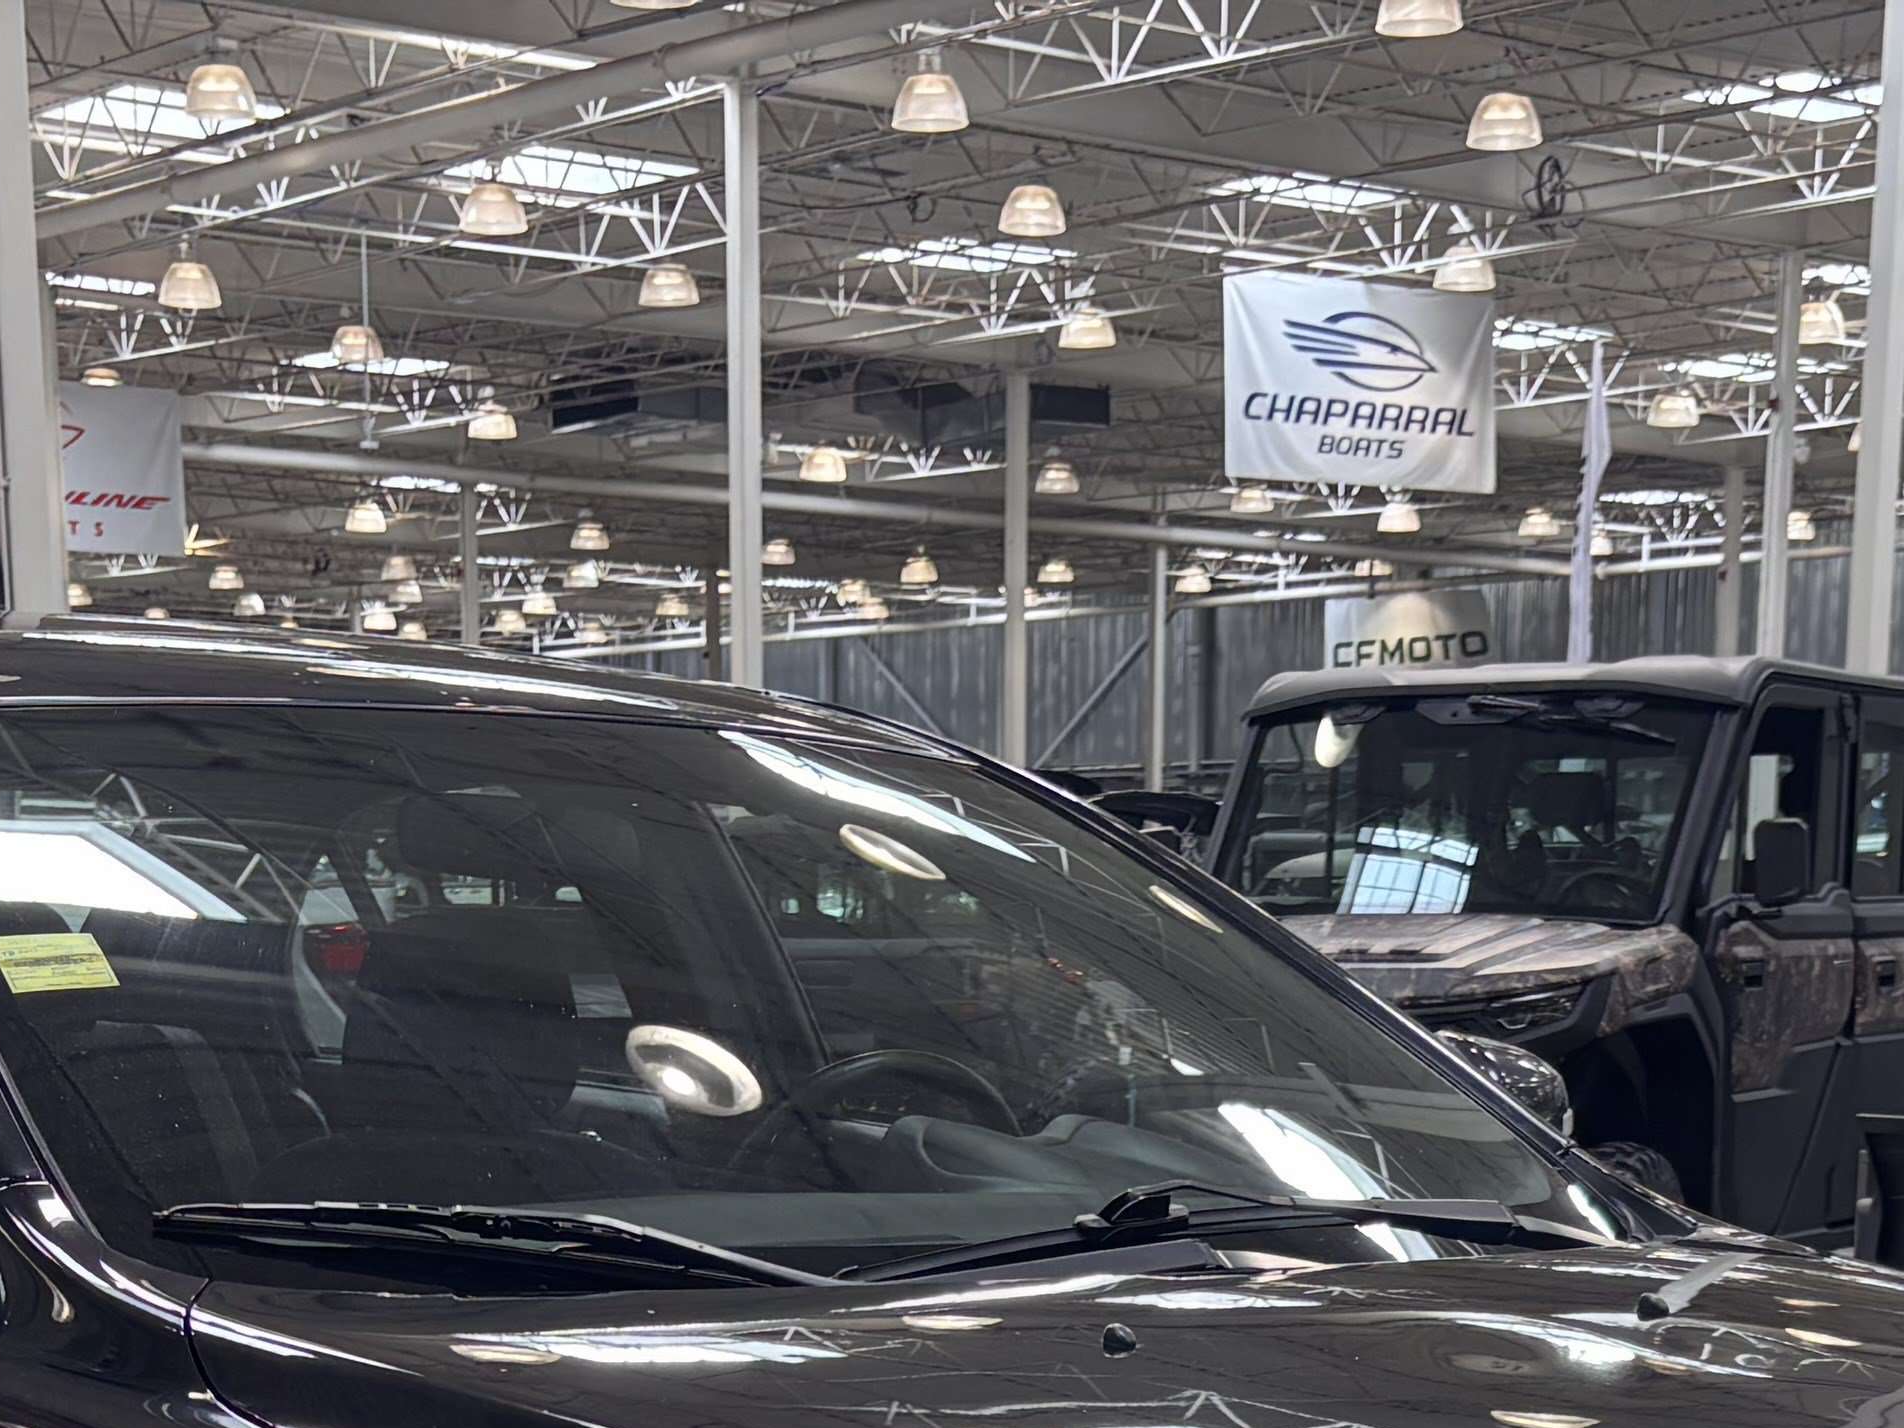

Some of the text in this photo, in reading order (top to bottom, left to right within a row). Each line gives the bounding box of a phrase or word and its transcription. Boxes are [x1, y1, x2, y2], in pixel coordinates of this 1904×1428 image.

[1244, 391, 1476, 437] CHAPARRAL
[1317, 434, 1405, 459] BOATS
[1333, 630, 1488, 668] CFMOTO
